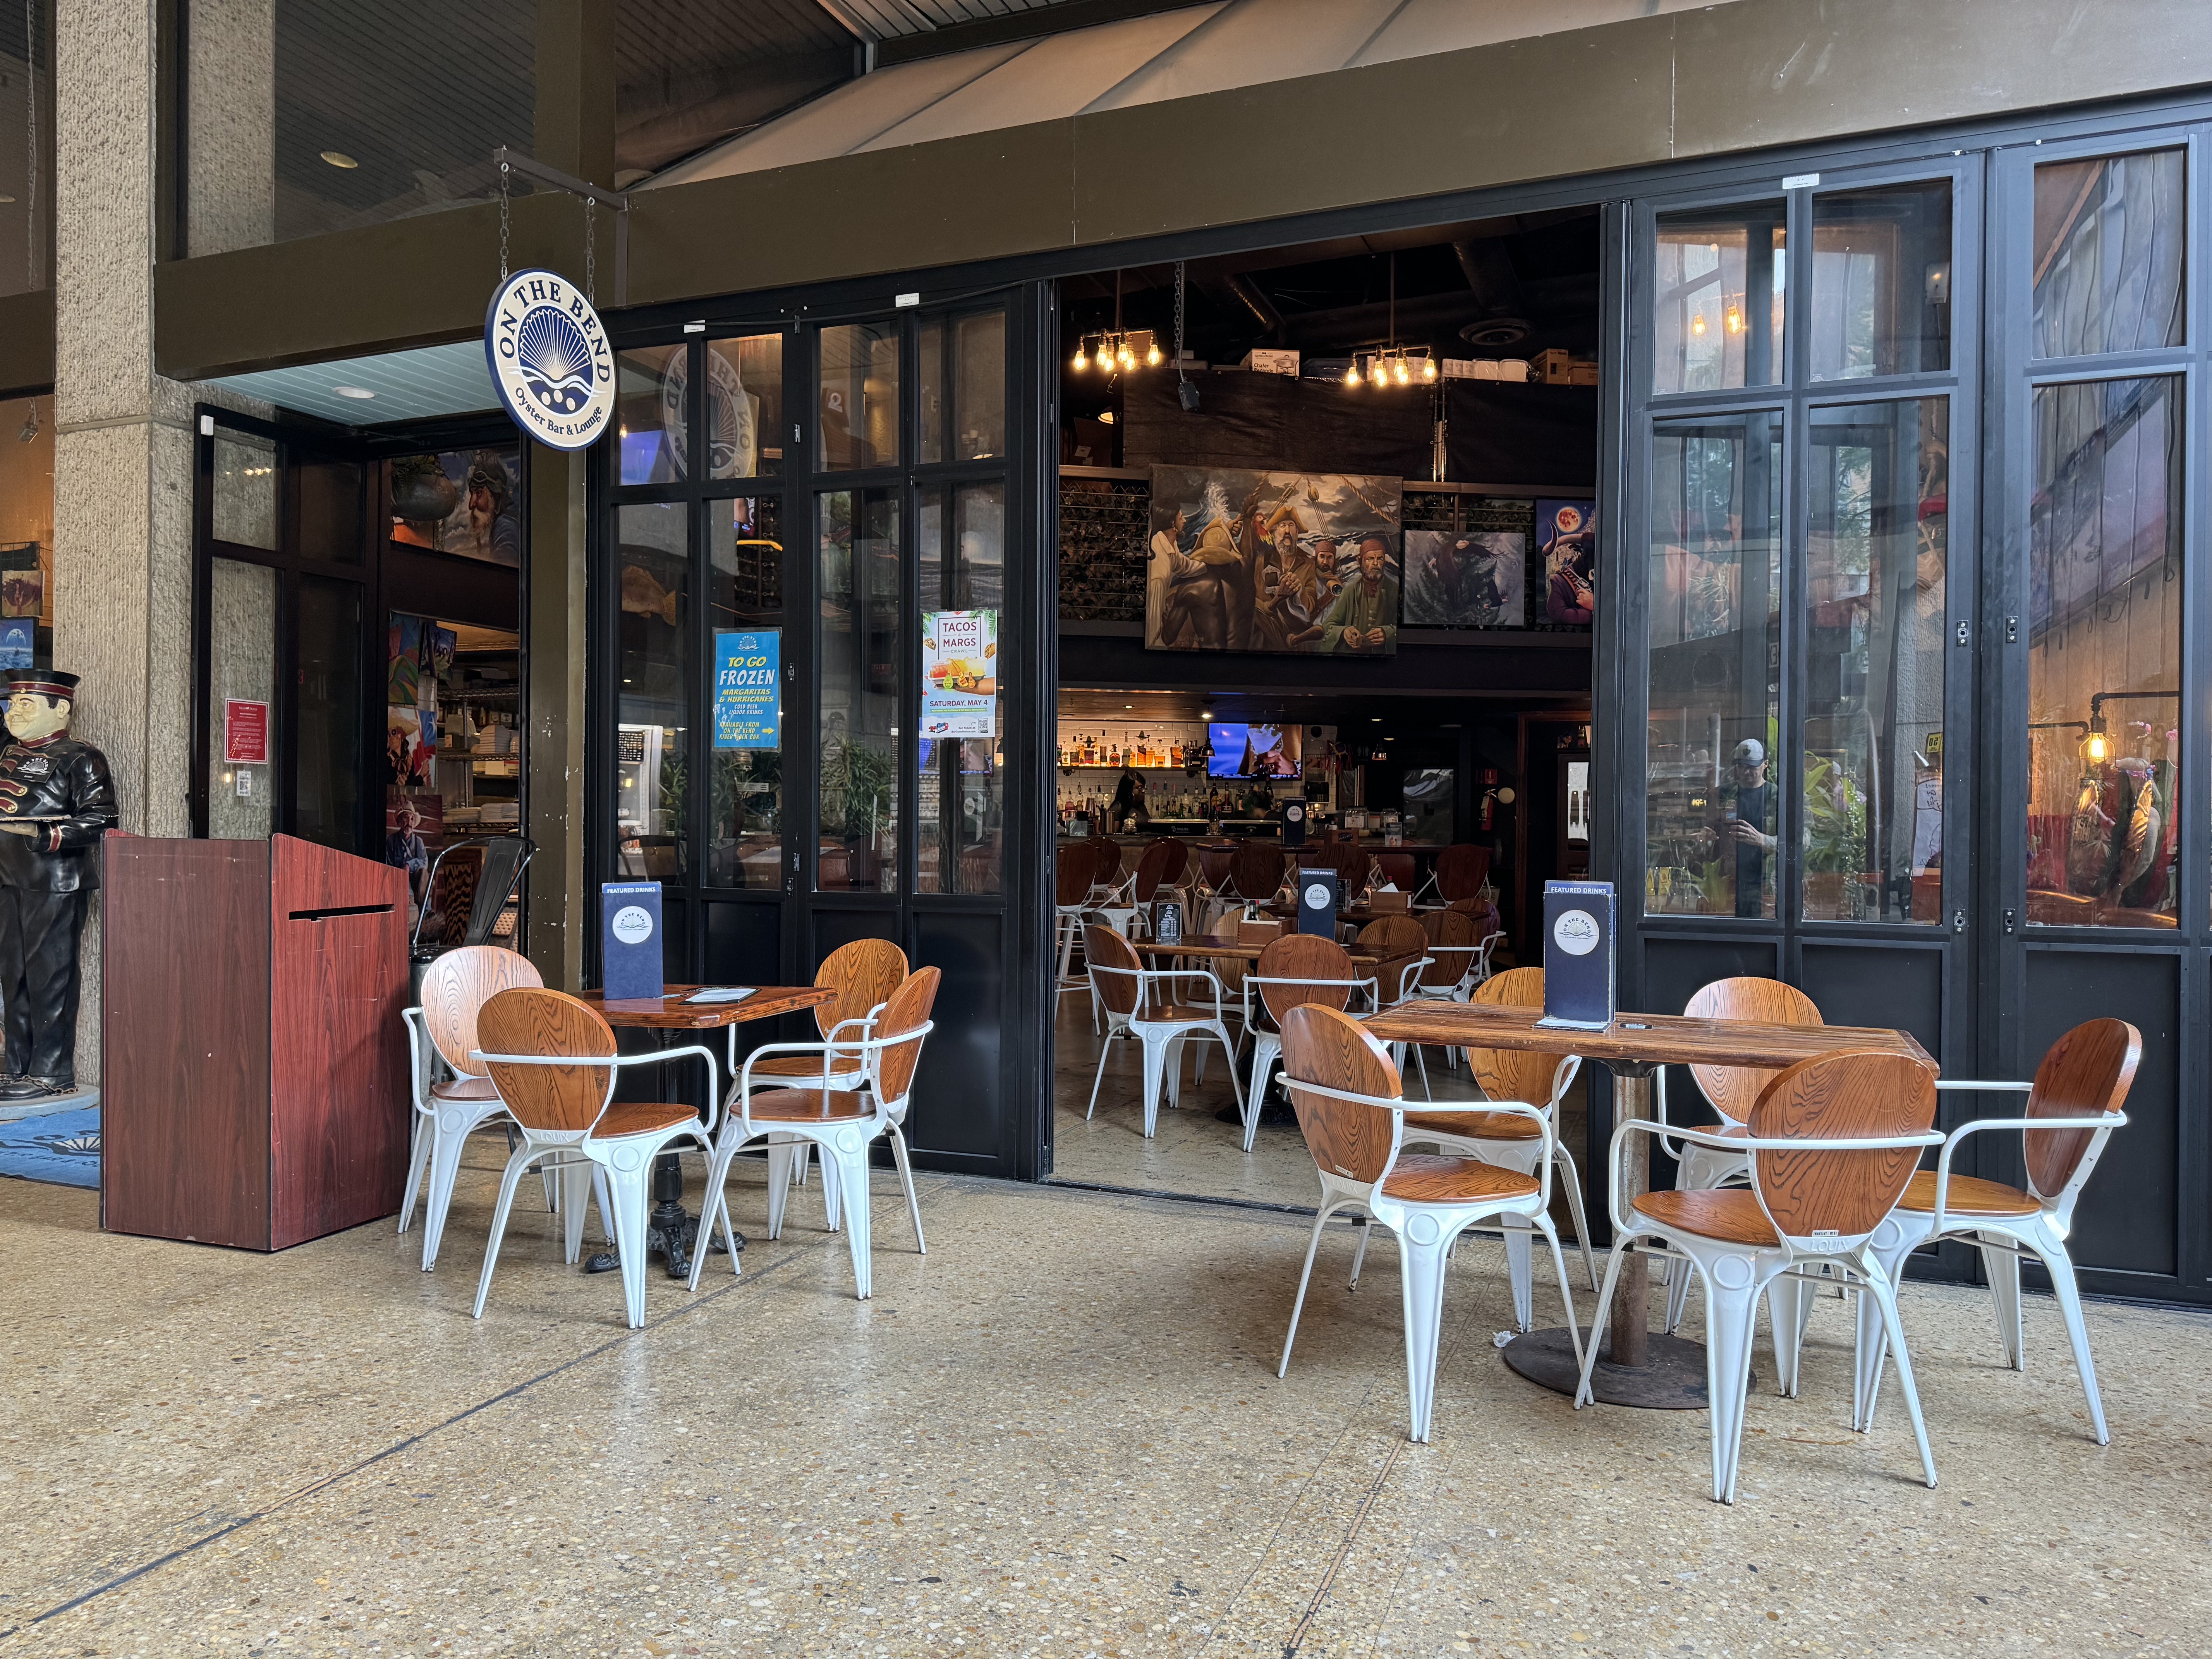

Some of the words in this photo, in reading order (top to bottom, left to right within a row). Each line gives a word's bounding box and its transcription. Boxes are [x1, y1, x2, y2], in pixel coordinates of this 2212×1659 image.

[500, 308, 518, 359] ON
[513, 280, 561, 308] THE
[569, 295, 610, 383] BEND
[515, 387, 546, 425] Oyster
[547, 419, 564, 434] Bar
[566, 424, 574, 435] &
[574, 406, 602, 435] Lounge
[943, 622, 977, 632] TACOS
[943, 638, 976, 647] MARGS
[728, 657, 744, 667] TO
[747, 656, 767, 667] GO
[719, 669, 775, 685] FROZEN
[1581, 919, 1591, 933] BEND
